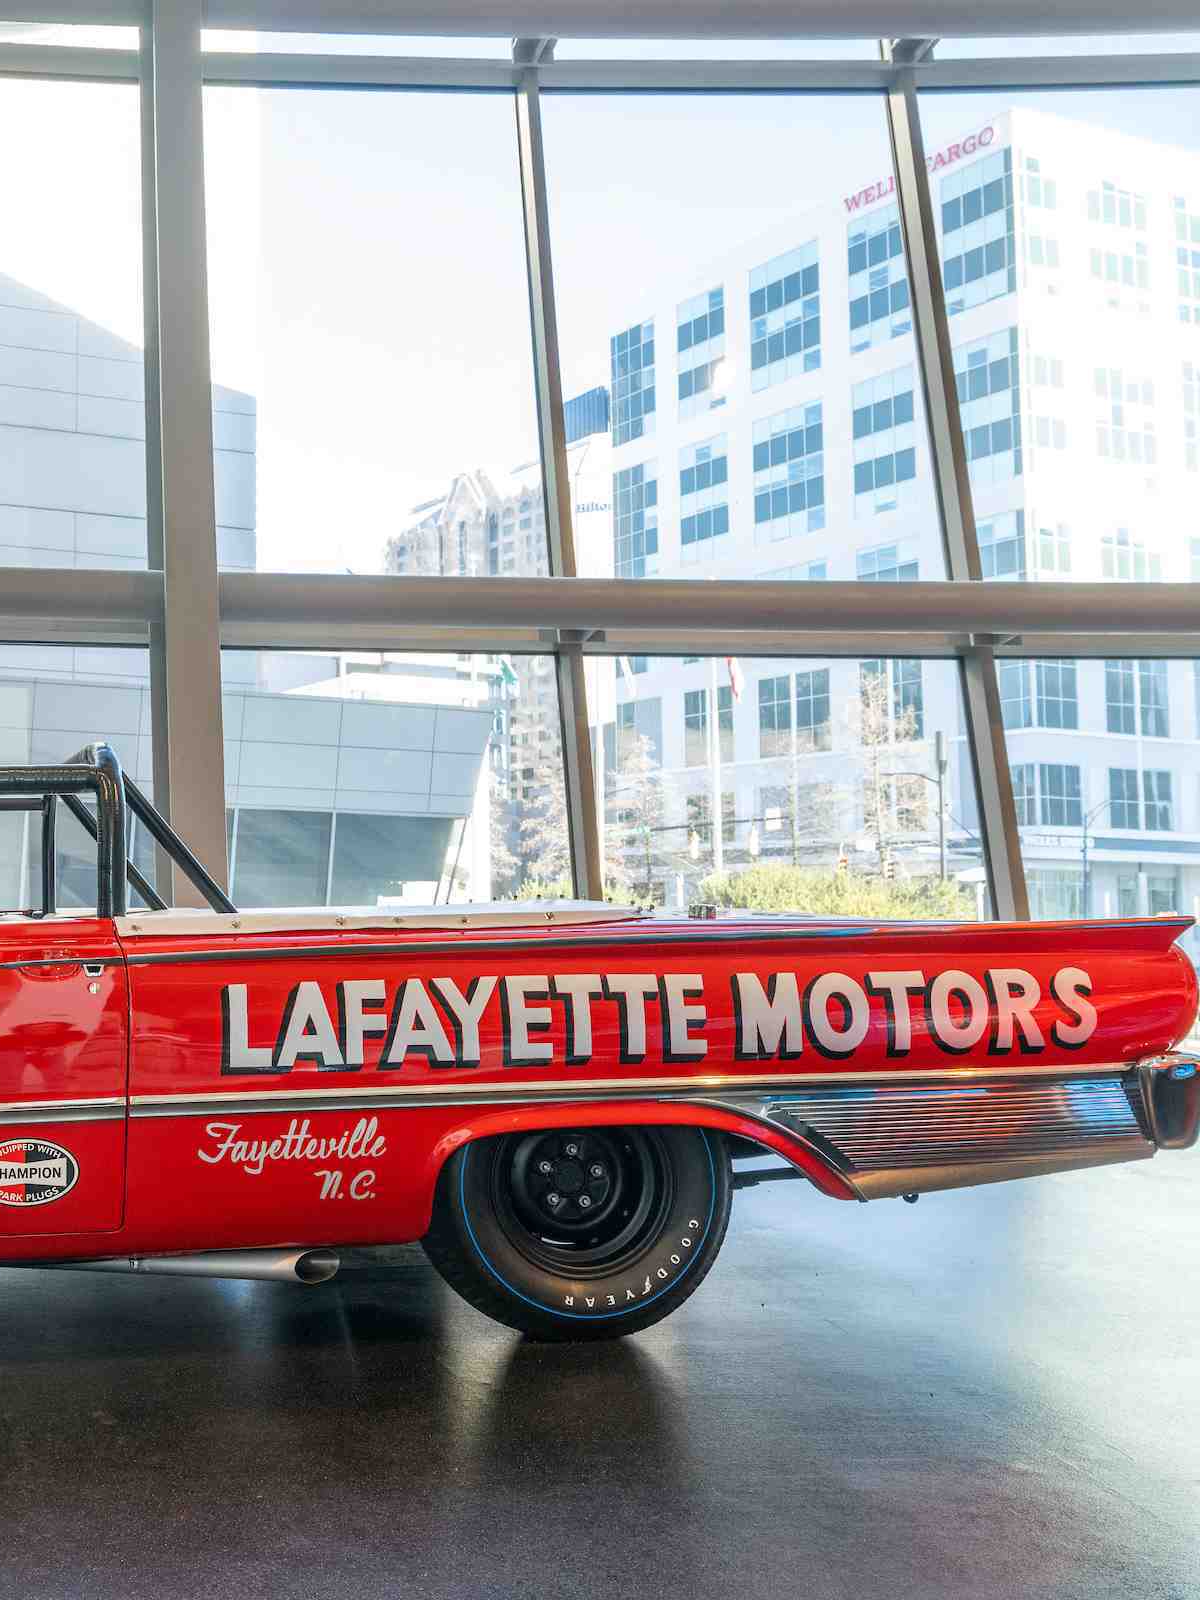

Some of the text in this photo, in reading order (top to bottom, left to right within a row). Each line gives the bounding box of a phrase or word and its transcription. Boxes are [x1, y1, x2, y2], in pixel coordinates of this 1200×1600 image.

[221, 966, 1098, 1076] LAFAYETTE MOTORS
[37, 1143, 61, 1159] WITH
[198, 1116, 387, 1175] Fayetteville
[26, 1186, 60, 1202] PLUGS
[313, 1169, 377, 1201] N.C.
[564, 1219, 699, 1308] GOODYEAR
